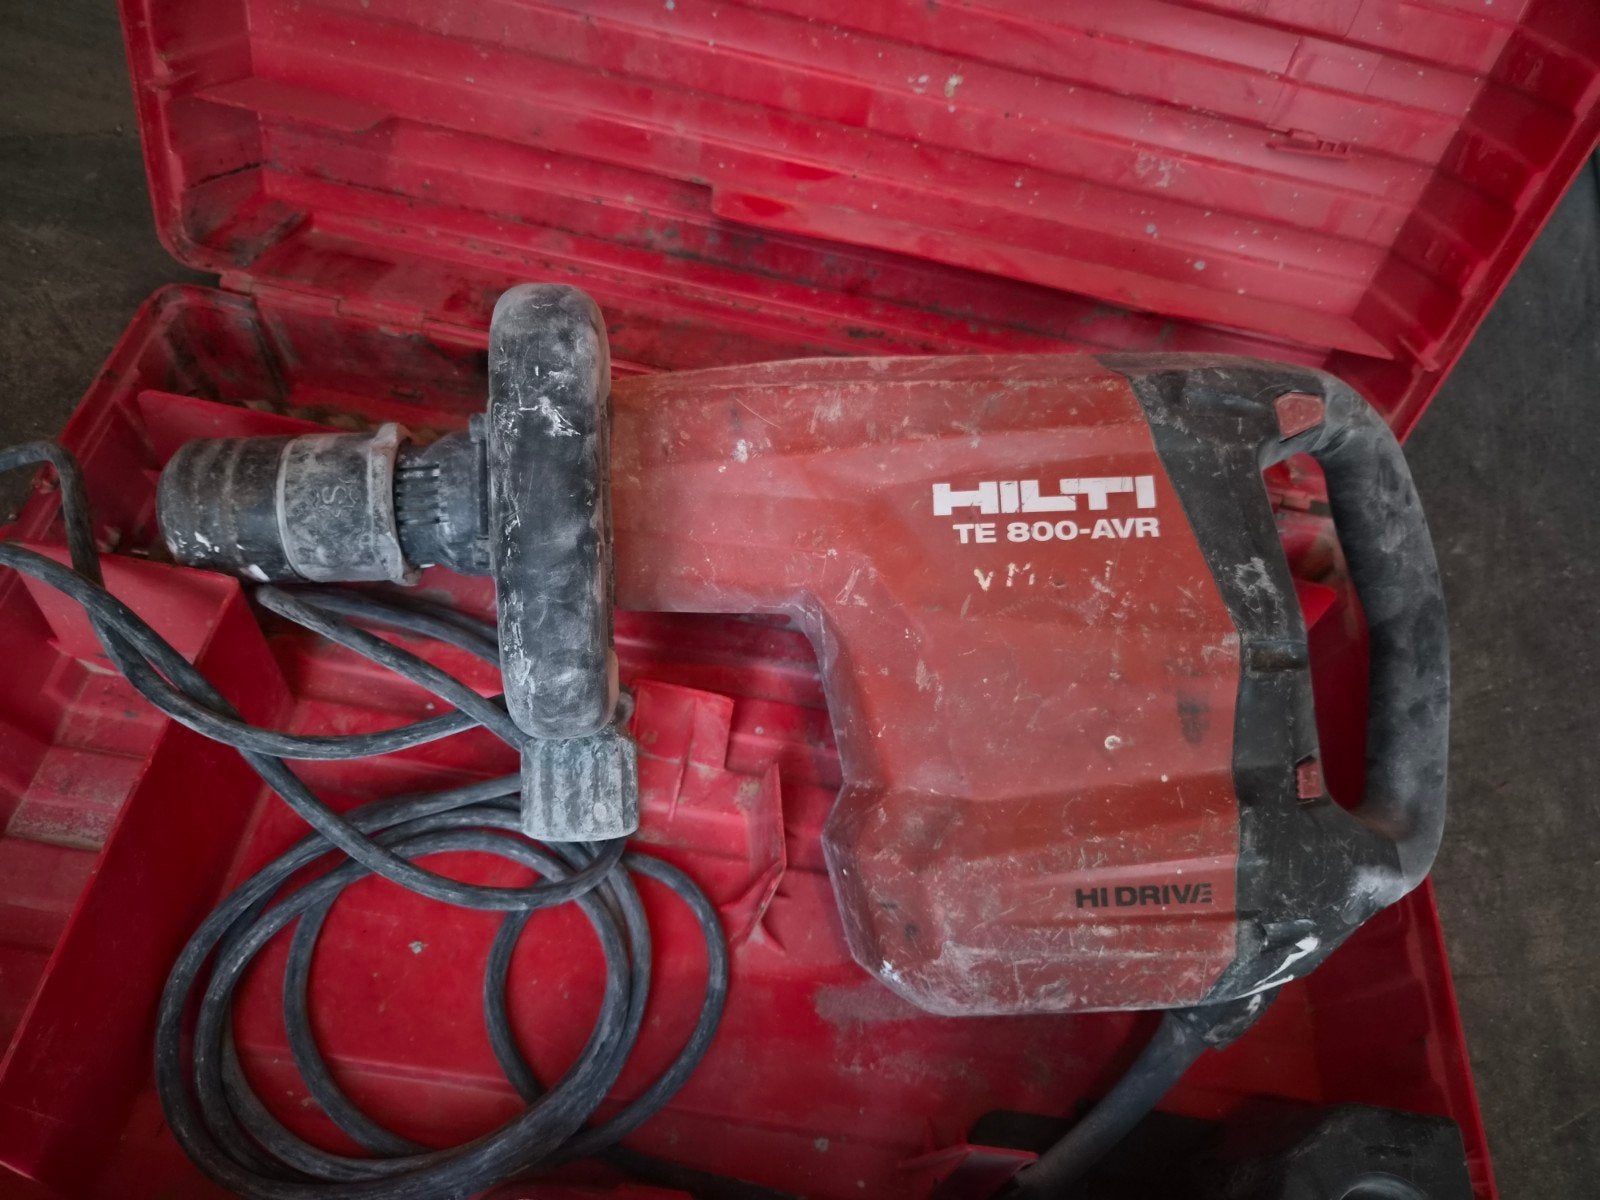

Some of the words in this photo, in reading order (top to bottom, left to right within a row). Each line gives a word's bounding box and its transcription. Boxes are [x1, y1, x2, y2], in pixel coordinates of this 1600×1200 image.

[932, 475, 1157, 516] HILTI
[952, 522, 997, 544] TE
[1006, 517, 1160, 543] 800-AVR
[1075, 887, 1109, 909] HI
[1114, 883, 1212, 907] DRIVE
